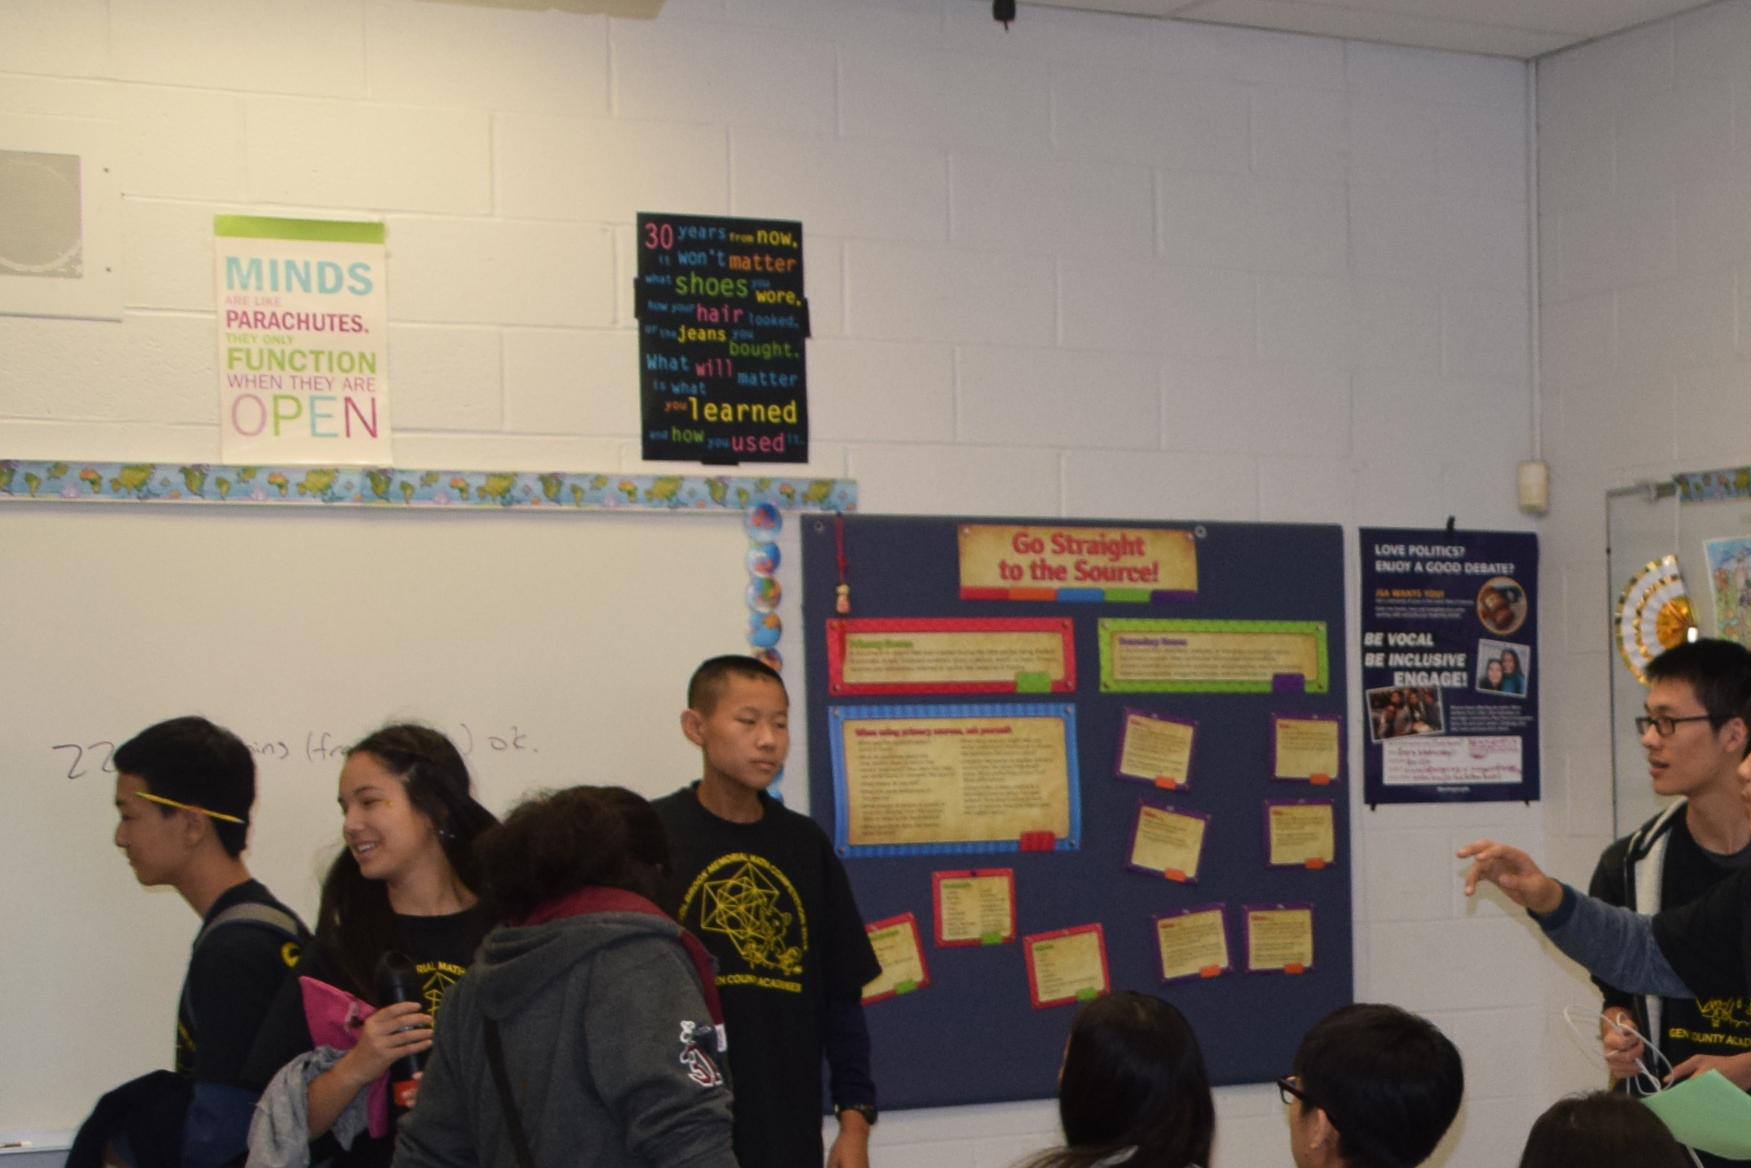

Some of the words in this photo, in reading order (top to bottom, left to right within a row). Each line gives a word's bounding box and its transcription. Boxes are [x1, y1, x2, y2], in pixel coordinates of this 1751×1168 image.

[645, 222, 674, 249] 30
[678, 224, 727, 241] years
[729, 232, 754, 243] from
[677, 249, 726, 268] won't
[728, 253, 797, 273] matter
[225, 256, 373, 296] MINDS
[645, 273, 672, 286] what
[675, 271, 748, 297] shoes
[225, 296, 250, 306] ARE
[254, 296, 282, 307] LIKE
[696, 303, 744, 323] hair
[226, 309, 370, 334] PARACHUTES.
[677, 324, 727, 343] jeans
[225, 333, 257, 344] THEY
[262, 333, 295, 346] ONLY
[227, 347, 377, 375] FUNCTION
[646, 354, 690, 371] What
[695, 358, 733, 377] will
[737, 371, 798, 388] matter
[227, 374, 283, 391] WHEN
[289, 374, 335, 391] THEY
[341, 376, 377, 393] ARE
[671, 381, 706, 396] what
[231, 393, 378, 438] OPEN
[664, 400, 688, 412] you
[688, 396, 798, 424] learned
[671, 426, 705, 444] how
[706, 436, 729, 449] you
[731, 433, 785, 453] used
[1011, 530, 1046, 555] Go
[1050, 531, 1147, 562] Straight
[1374, 543, 1406, 556] LOVE
[1408, 545, 1466, 558] POLITICS?
[998, 559, 1024, 581] to
[1029, 558, 1067, 582] the
[1073, 559, 1160, 583] Source!
[1374, 559, 1411, 573] ENJOY
[1414, 561, 1424, 573] A
[1426, 560, 1462, 574] GOOD
[1464, 561, 1515, 575] DEBATE?
[1364, 632, 1384, 646] BE
[1387, 631, 1435, 647] VOCAL
[1364, 652, 1385, 667] BE
[1388, 652, 1467, 668] INCLUSIVE
[1393, 670, 1468, 688] ENGAGE!
